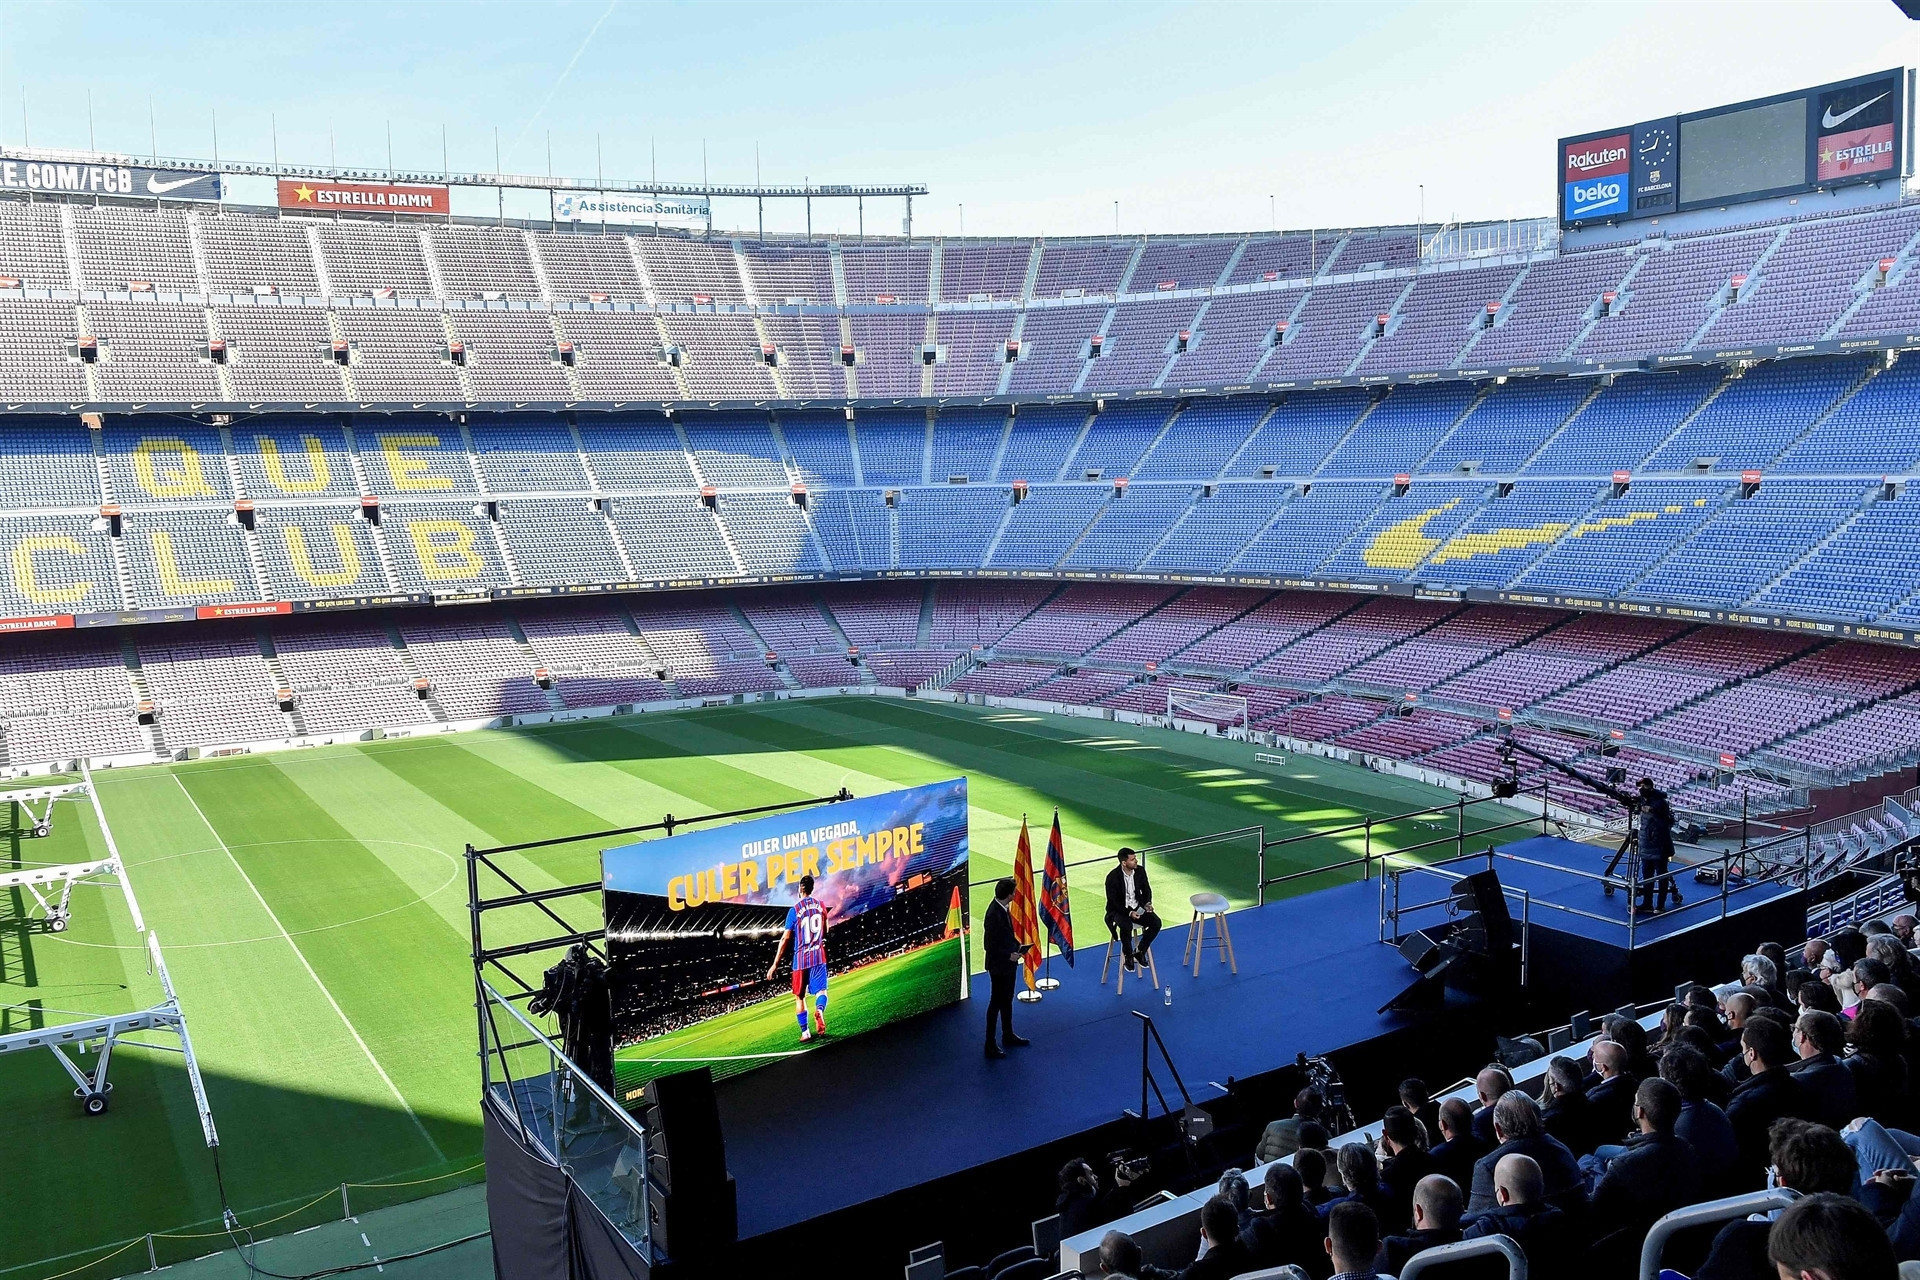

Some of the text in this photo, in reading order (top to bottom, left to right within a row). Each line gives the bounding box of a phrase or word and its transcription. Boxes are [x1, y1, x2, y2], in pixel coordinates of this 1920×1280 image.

[1568, 147, 1627, 169] Rakuten
[1836, 140, 1893, 161] ESTRELLA
[0, 162, 132, 193] E.COM/FCB
[1644, 182, 1672, 192] BARCELONA
[317, 190, 433, 207] ESTRELLA DAMM
[1573, 182, 1620, 203] beko
[579, 200, 711, 216] Assistència Sanitària
[131, 432, 456, 498] QUE
[11, 519, 484, 605] CLUB
[224, 606, 256, 616] ESTRELLA
[1728, 613, 1768, 624] MÉS QUE TALENT
[34, 619, 57, 628] DAMM
[1816, 623, 1835, 632] TALENT
[1856, 627, 1867, 635] MÉS
[1868, 629, 1879, 638] QUE
[1890, 632, 1904, 640] CLUB
[742, 820, 860, 859] CULER UNA VEGADA,
[667, 822, 924, 912] CULER PER SEMPRE
[800, 913, 823, 944] 19
